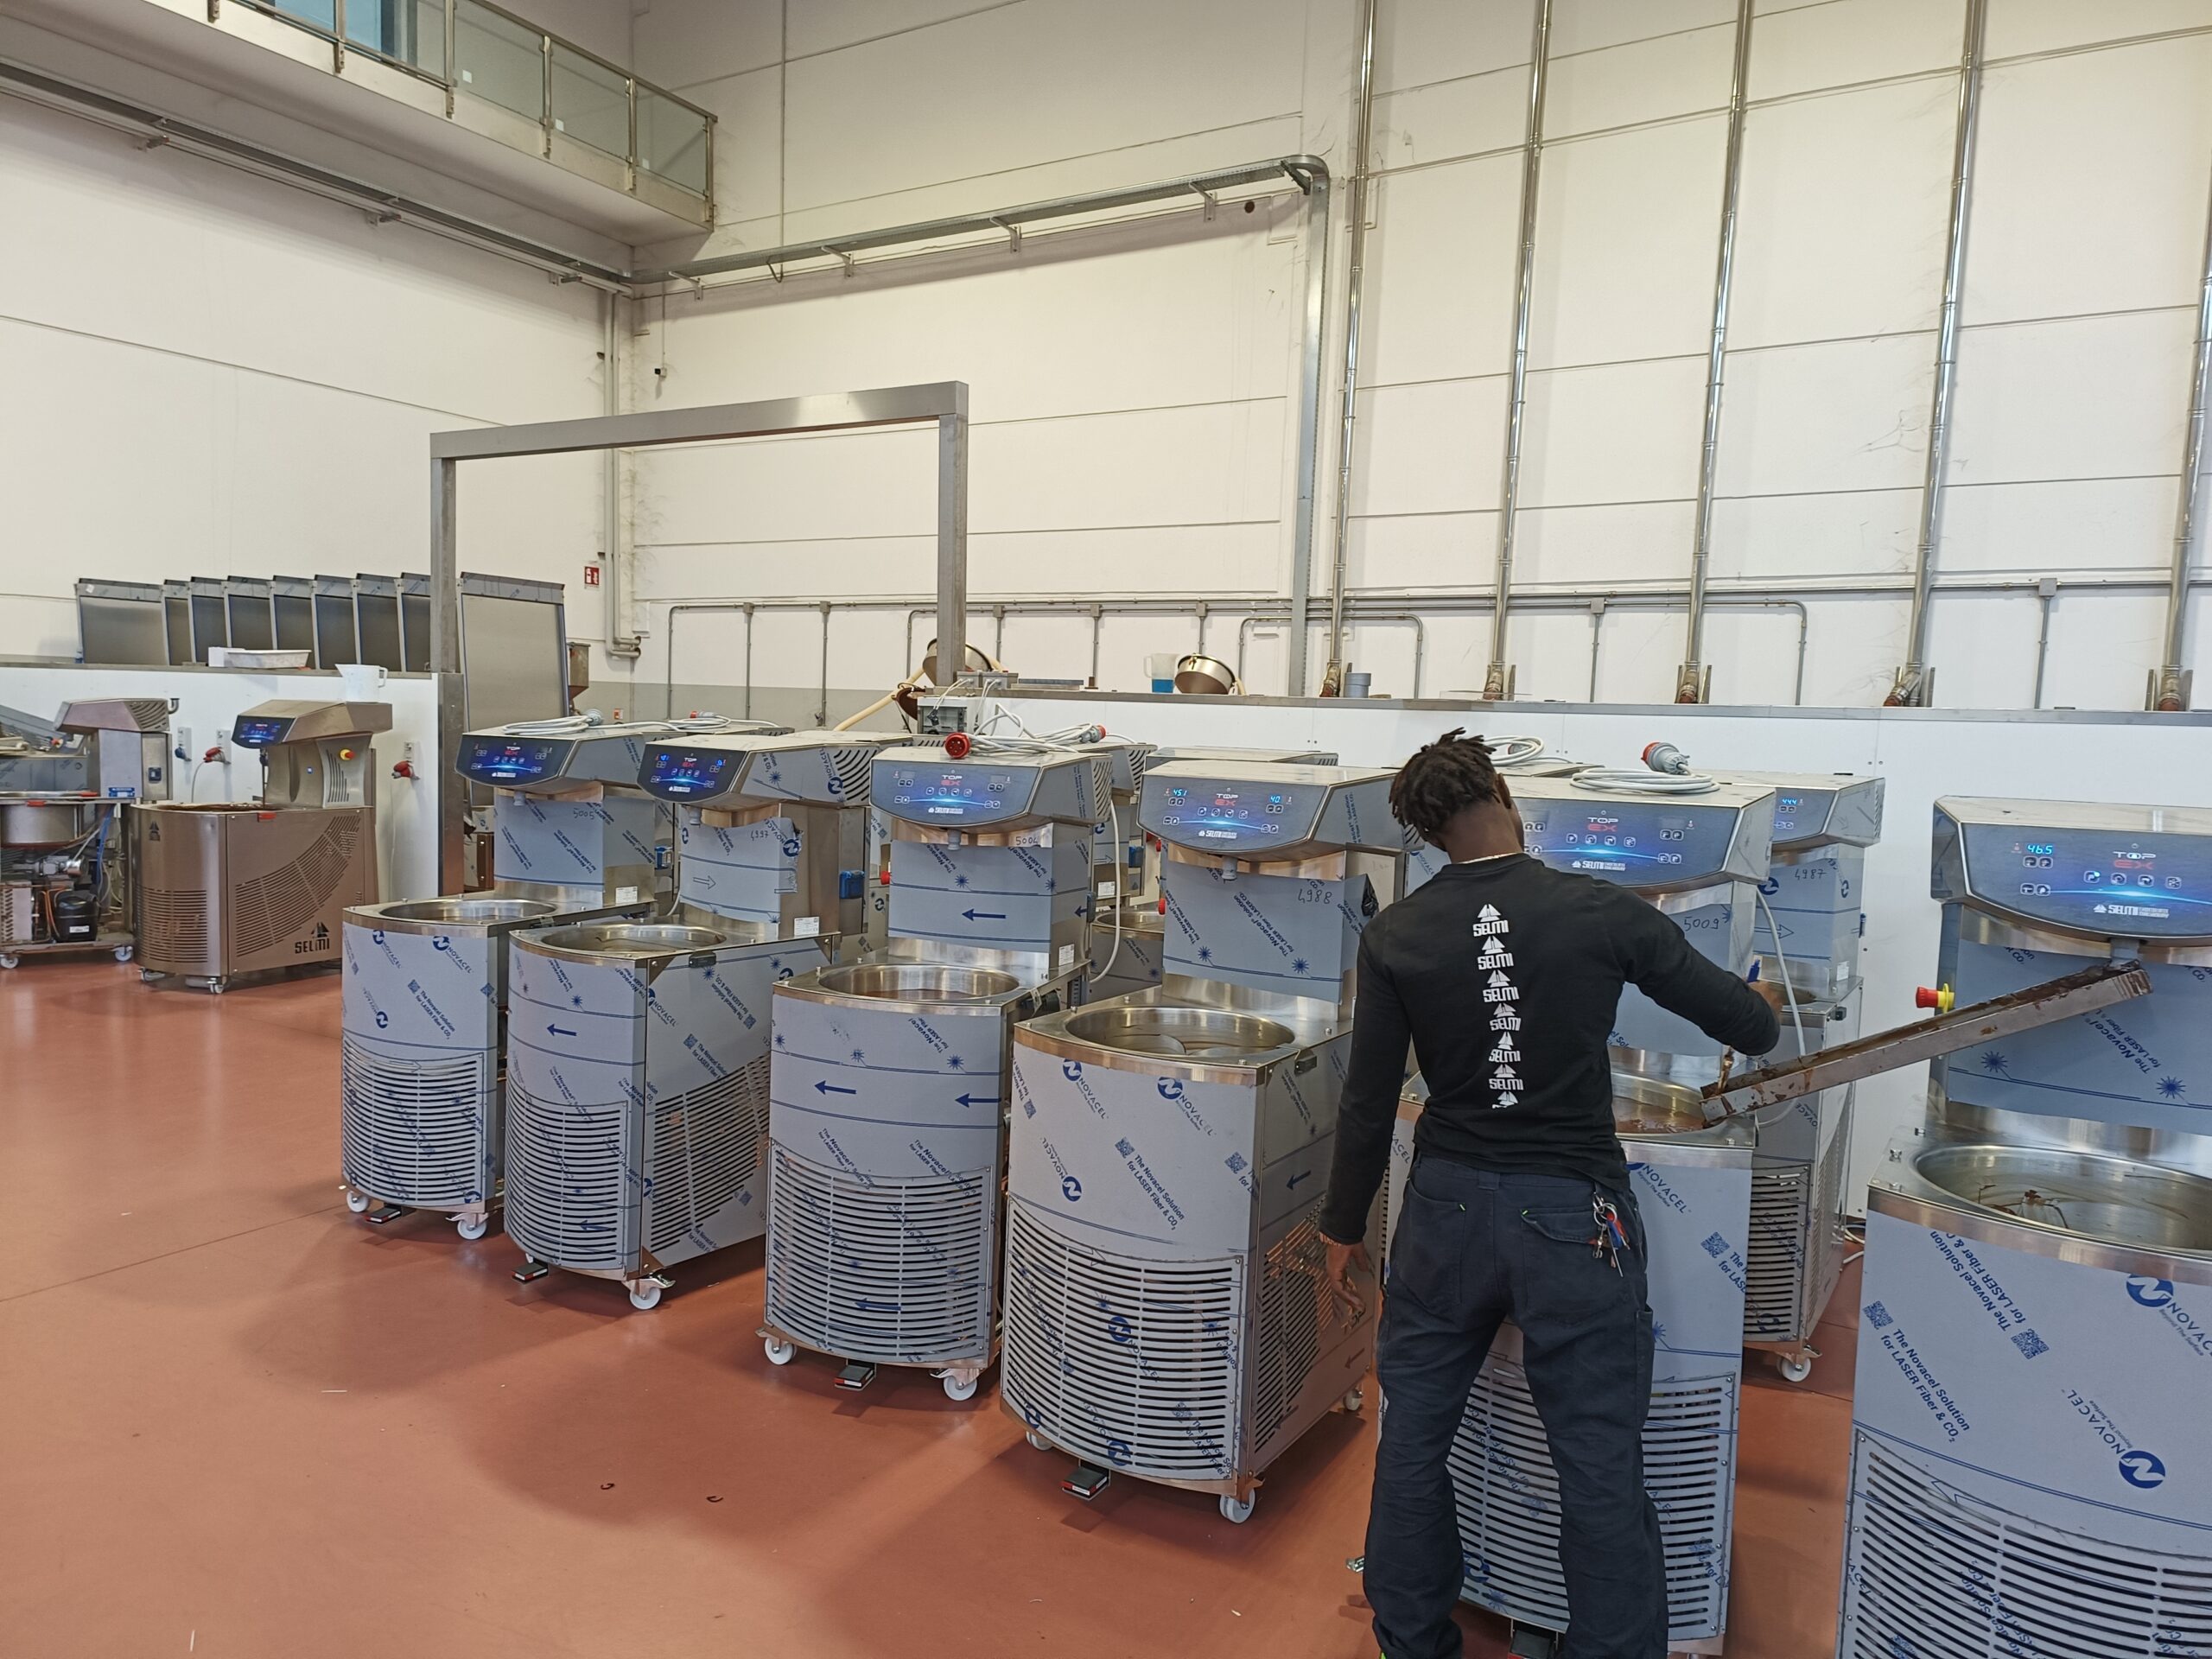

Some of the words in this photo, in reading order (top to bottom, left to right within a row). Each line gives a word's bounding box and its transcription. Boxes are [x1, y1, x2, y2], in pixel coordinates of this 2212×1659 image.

[925, 842, 945, 866] Novace
[2113, 851, 2156, 860] TOP
[1794, 868, 1827, 880] 4987
[2114, 860, 2153, 869] EX
[1232, 894, 1254, 918] Solution
[1298, 888, 1332, 905] 4988
[1246, 899, 1262, 916] LASER
[2108, 905, 2138, 915] SELMI
[1472, 920, 1509, 937] SELMI
[1684, 916, 1719, 931] 5009
[295, 938, 330, 954] SELMI
[1272, 928, 1288, 946] LASER
[446, 945, 474, 974] NOVACEL
[1276, 944, 1288, 957] The
[1478, 953, 1514, 969] SELMI
[1483, 987, 1519, 1002] SELMI
[652, 1000, 677, 1027] NOVACEL
[907, 1016, 935, 1046] Novacel
[1490, 1018, 1521, 1031] SELMI
[2104, 1016, 2127, 1039] Fiber
[931, 1042, 944, 1054] The
[1489, 1049, 1521, 1063] SELMI
[2123, 1033, 2152, 1060] LASER
[2132, 1056, 2152, 1076] The
[2146, 1055, 2162, 1071] for
[1489, 1079, 1523, 1090] SELMI
[1077, 1077, 1108, 1119] NOVACEL
[1177, 1093, 1215, 1137] NOVACEL
[820, 1127, 832, 1139] The
[1039, 1136, 1065, 1179] NOVACEL
[1125, 1159, 1138, 1173] for
[1133, 1169, 1154, 1194] LASER
[1147, 1191, 1165, 1211] Fiber
[1160, 1208, 1171, 1217] &
[1132, 1154, 1147, 1169] The
[1141, 1166, 1166, 1194] Novacel
[1160, 1191, 1186, 1220] Solution
[1642, 1162, 1688, 1214] NOVACEL
[1648, 1183, 1658, 1193] The
[1927, 1227, 1967, 1273] Solution
[1952, 1237, 1966, 1250] &
[1717, 1258, 1733, 1274] for
[1728, 1250, 1745, 1268] The
[1960, 1247, 1987, 1277] Fiber
[1958, 1267, 1999, 1314] Novacel
[1980, 1273, 2014, 1310] LASER
[1991, 1309, 2013, 1333] The
[2007, 1305, 2028, 1326] for
[2165, 1299, 2212, 1357] NOVAC
[2173, 1325, 2188, 1340] The
[2183, 1335, 2205, 1357] Surface
[1878, 1332, 1897, 1352] for
[1890, 1348, 1921, 1387] LASER
[1915, 1383, 1939, 1412] Fiber
[1934, 1410, 1948, 1424] &
[1890, 1326, 1911, 1350] The
[1904, 1345, 1940, 1389] Novacel
[1933, 1385, 1971, 1433] Solution
[2087, 1397, 2108, 1421] Surface
[2064, 1388, 2126, 1457] NOVACEL
[2104, 1417, 2117, 1431] The
